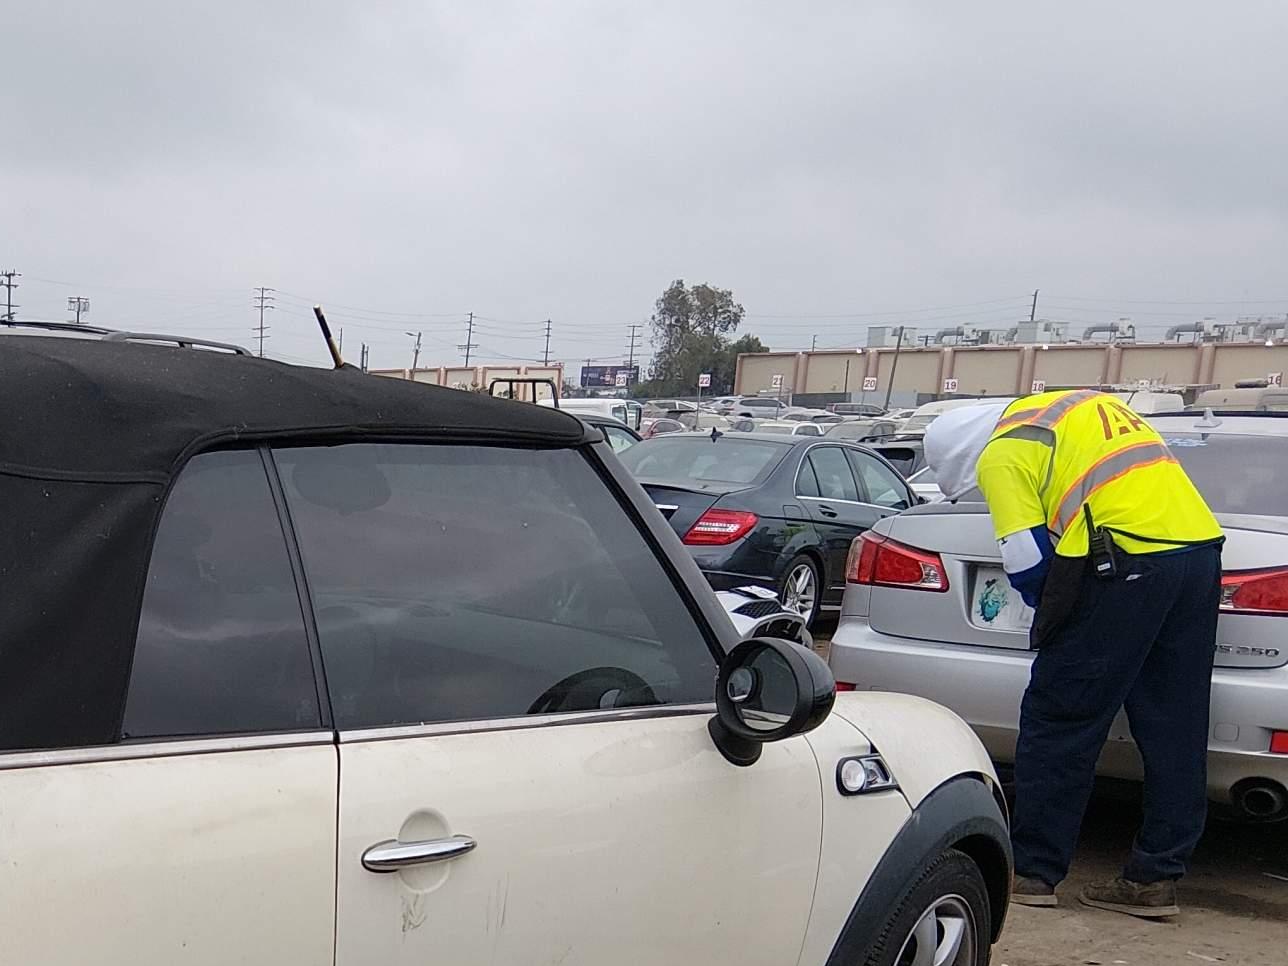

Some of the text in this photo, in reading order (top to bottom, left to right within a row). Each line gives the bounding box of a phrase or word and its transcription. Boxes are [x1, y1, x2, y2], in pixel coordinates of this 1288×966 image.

[699, 376, 710, 386] 22
[864, 379, 876, 389] 20
[945, 381, 957, 391] 19
